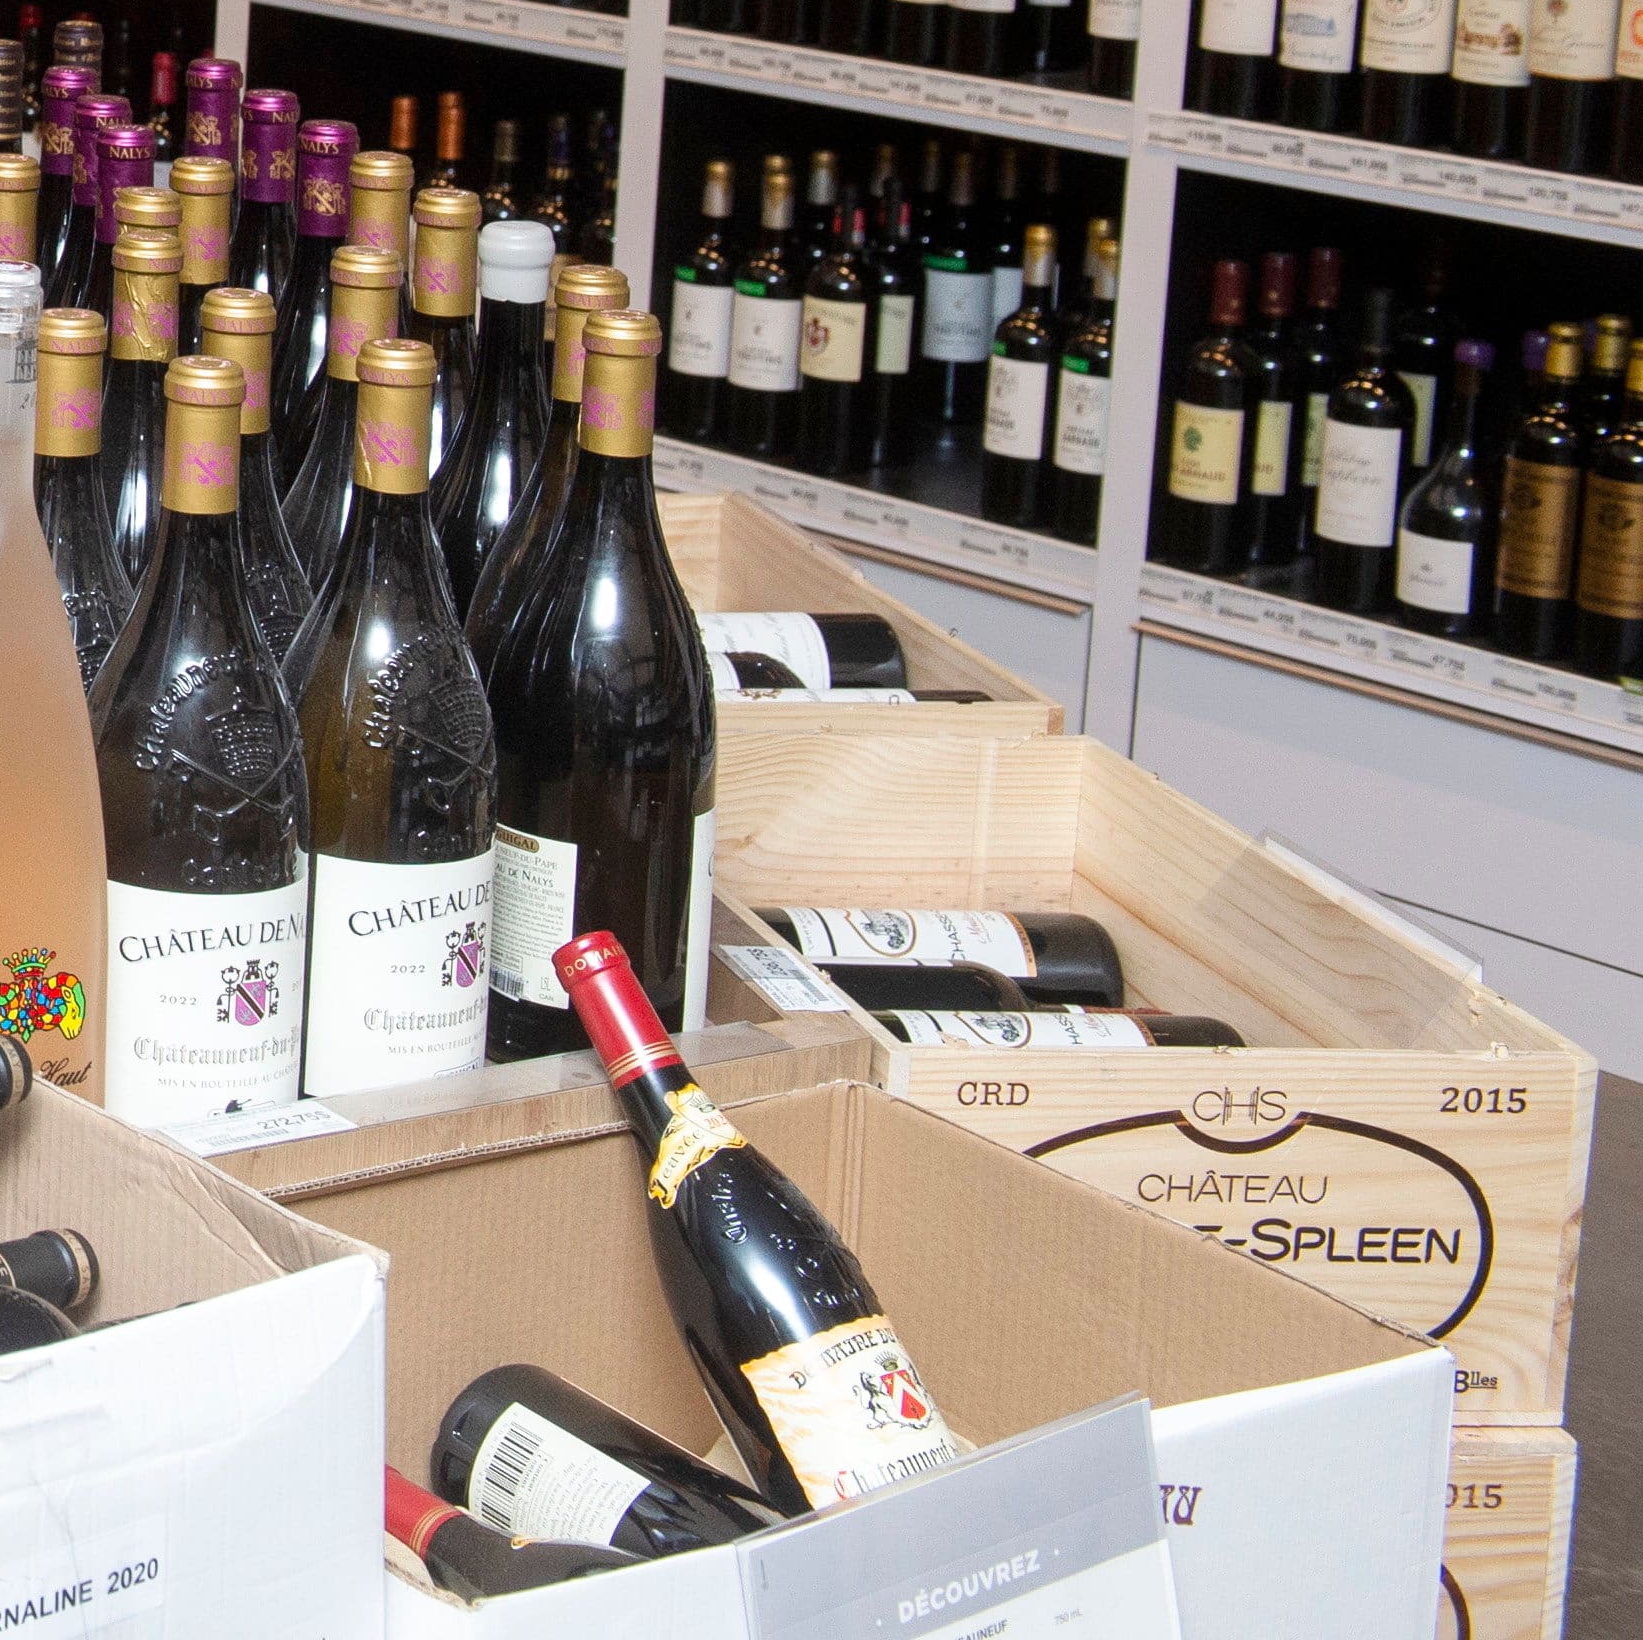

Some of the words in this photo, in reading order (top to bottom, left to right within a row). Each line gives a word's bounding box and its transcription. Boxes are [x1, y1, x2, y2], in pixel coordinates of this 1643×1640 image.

[186, 74, 214, 89] ALYS
[109, 144, 152, 160] NALYS
[301, 140, 340, 155] NALYS
[176, 389, 231, 405] NALYS
[522, 870, 555, 889] NALYS
[348, 887, 472, 937] CHÂTEAU
[119, 923, 253, 963] CHÂTEAU
[259, 918, 286, 945] DE
[390, 964, 426, 974] 2022
[159, 994, 198, 1006] 2022
[39, 1057, 92, 1088] Haut
[957, 1080, 1031, 1109] CRD
[1439, 1086, 1529, 1116] 2015
[1135, 1172, 1329, 1205] CHÂTEAU
[1190, 1217, 1462, 1265] -SPLEEN
[1443, 1484, 1504, 1511] 015
[106, 1557, 159, 1596] 2020
[897, 1548, 1042, 1624] DÉCOUVREZ
